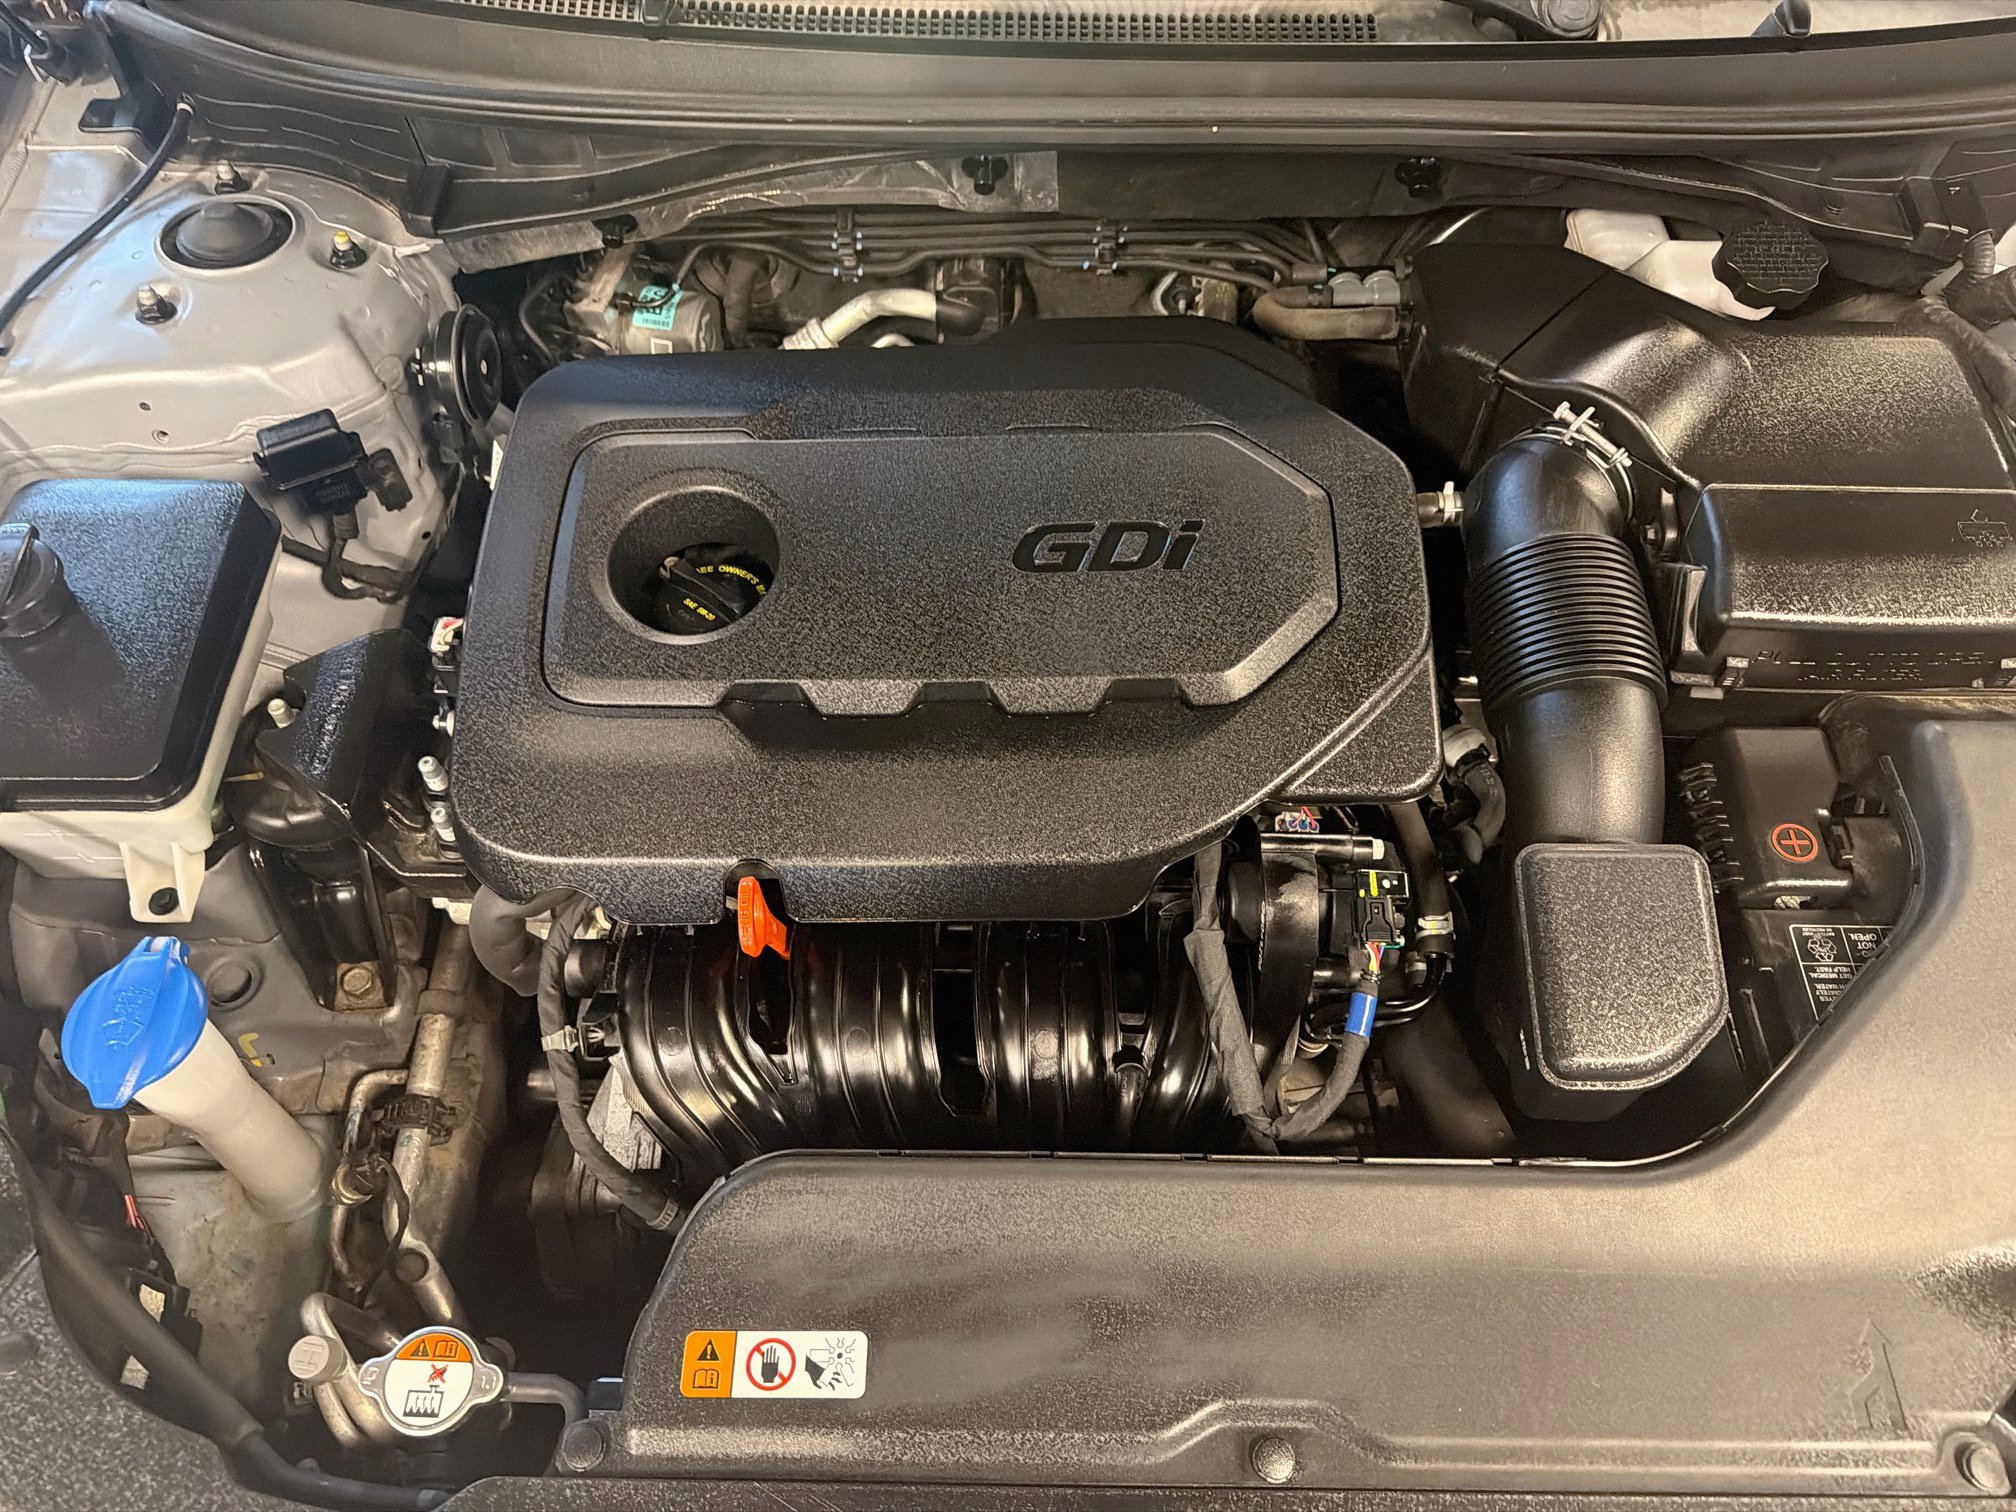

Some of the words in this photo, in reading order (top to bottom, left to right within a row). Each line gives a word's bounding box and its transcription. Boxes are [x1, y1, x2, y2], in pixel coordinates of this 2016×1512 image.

[1012, 518, 1205, 573] GDi
[1847, 932, 1877, 941] OPEN.
[1857, 941, 1876, 949] NOT
